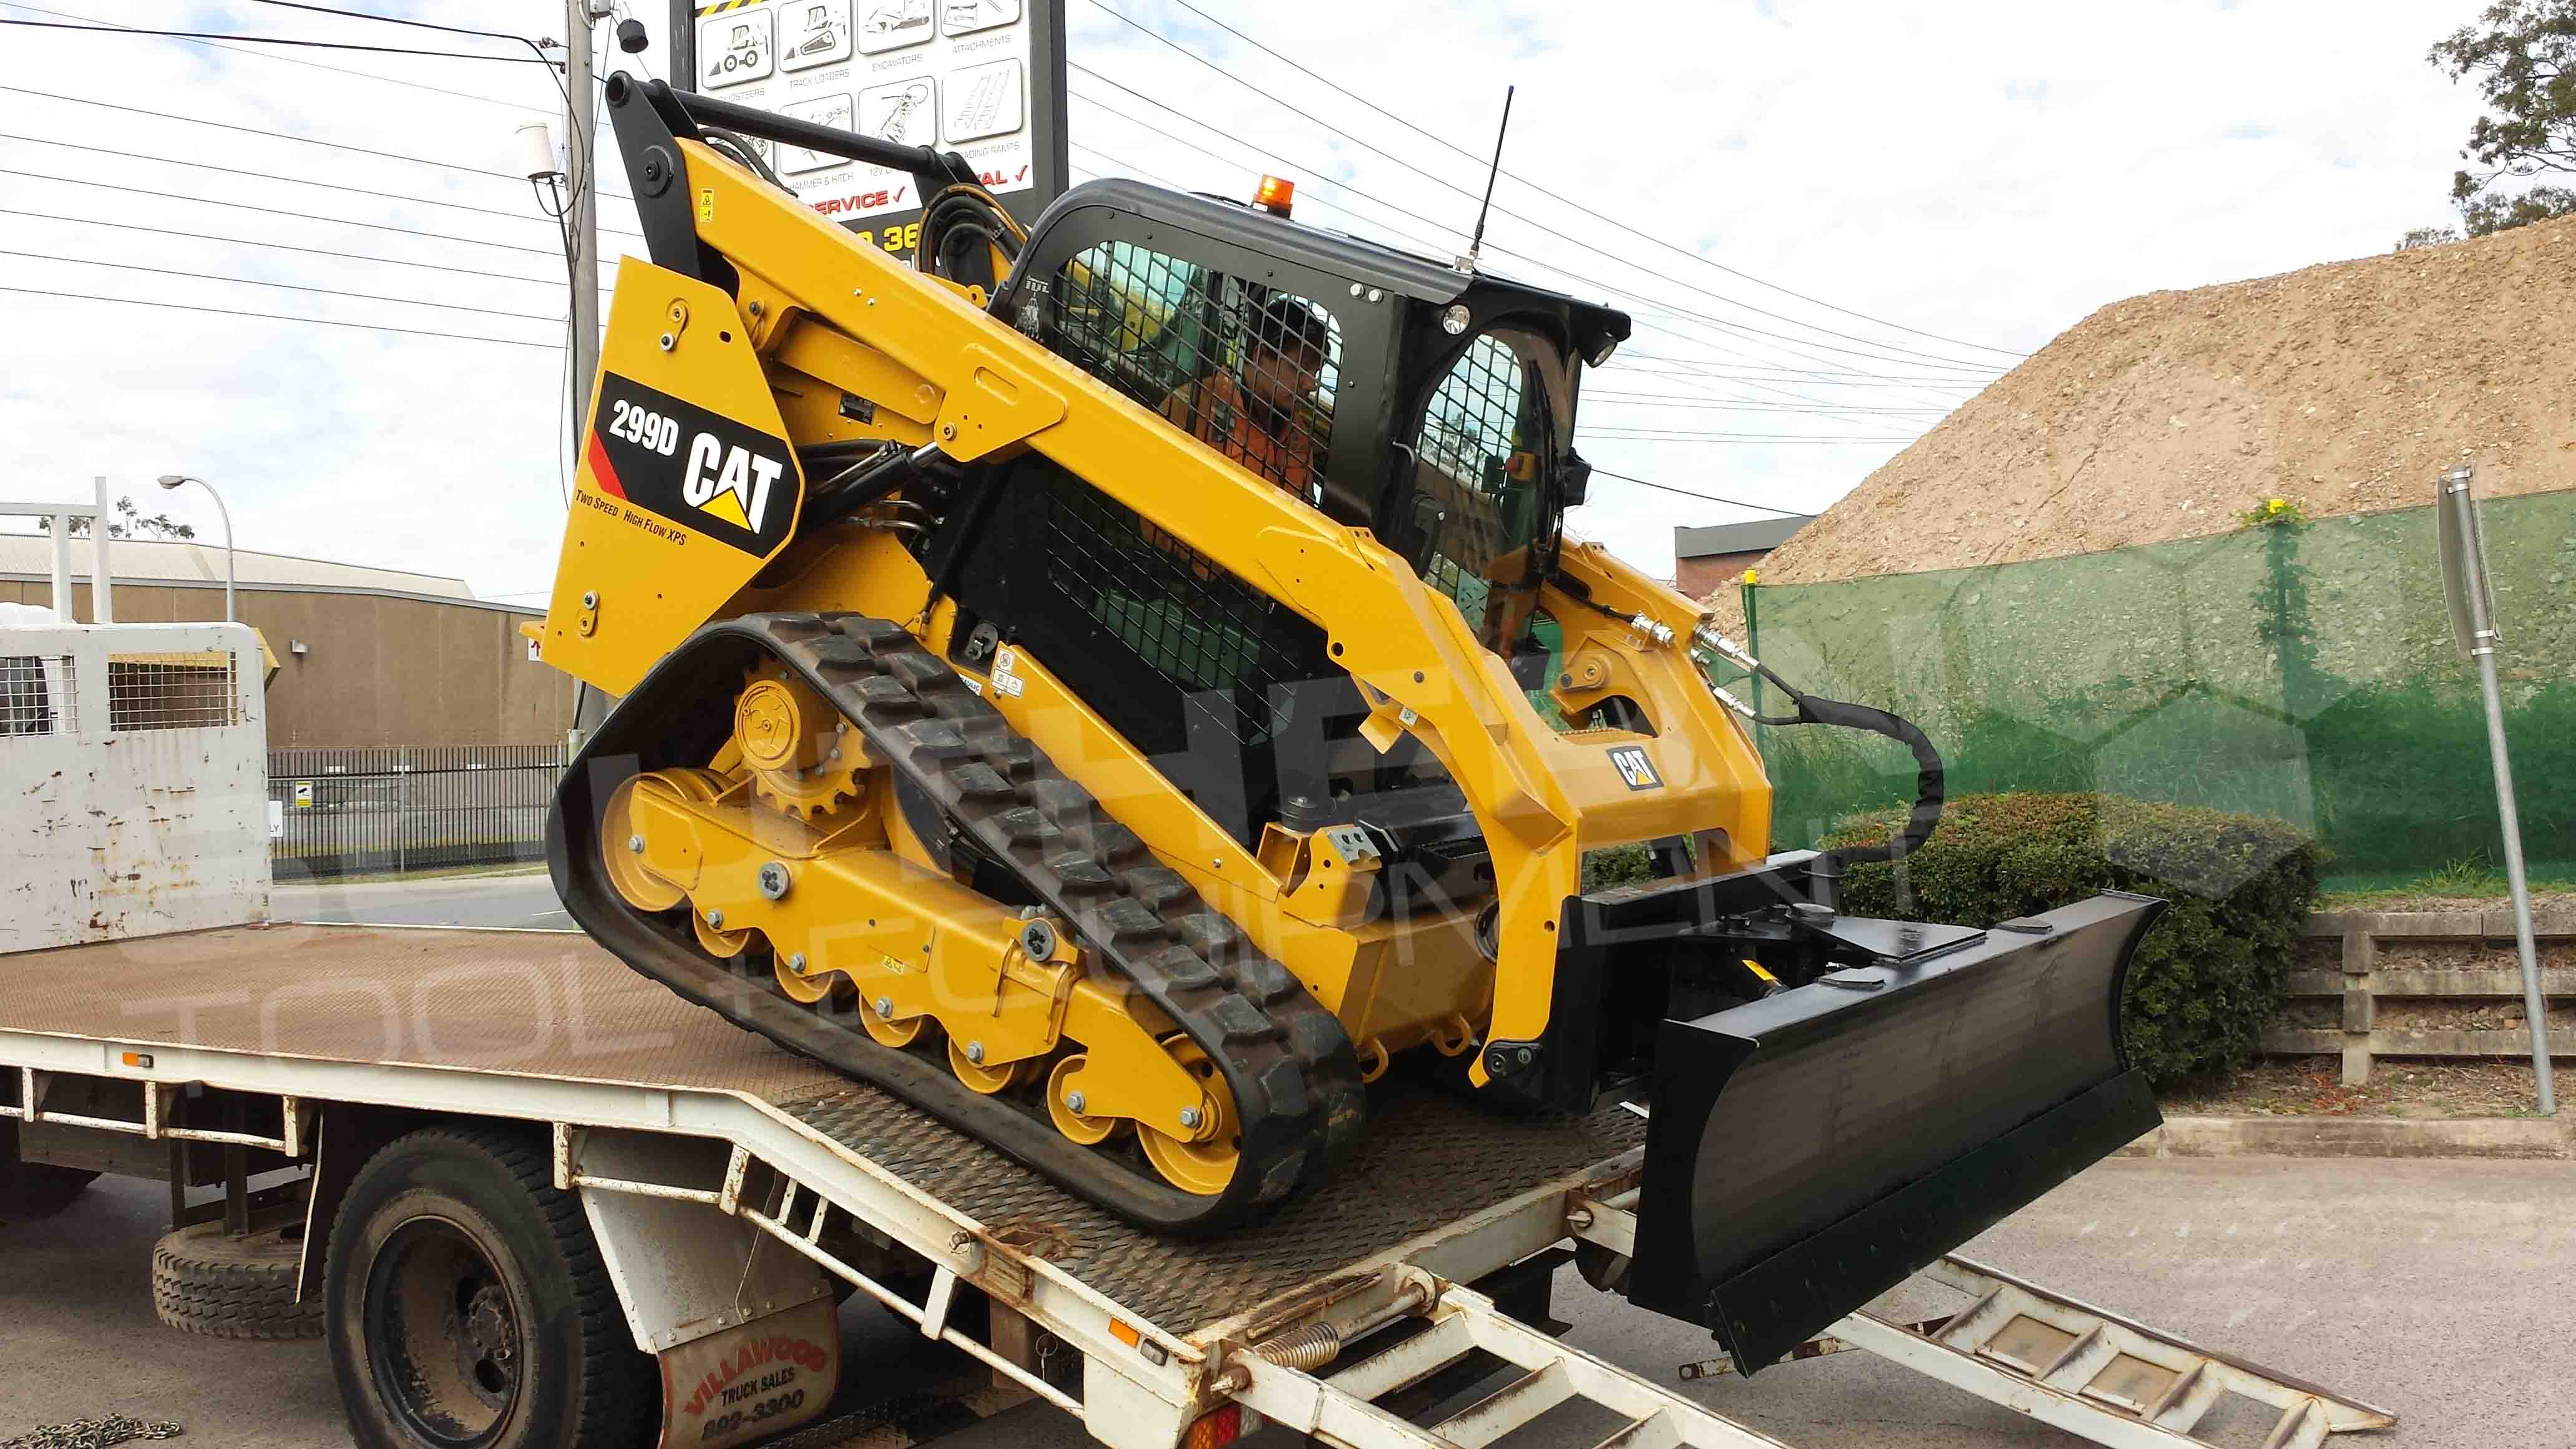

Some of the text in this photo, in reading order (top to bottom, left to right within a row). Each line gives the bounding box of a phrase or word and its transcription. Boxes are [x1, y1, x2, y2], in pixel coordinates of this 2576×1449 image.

[952, 34, 1012, 54] ATTACHMENTS
[872, 54, 924, 72] EXCAVATORS
[788, 69, 849, 90] TRACK LOADERS
[991, 141, 1020, 155] RAMPS
[789, 177, 822, 190] HAMMER
[832, 172, 854, 185] HITCH
[608, 399, 679, 456] 299D
[682, 432, 783, 535] CAT
[667, 529, 687, 546] XPS
[1613, 750, 1657, 786] CAT
[683, 1336, 826, 1415] VILLAWOOD
[720, 1367, 795, 1407] TRUCK SALES
